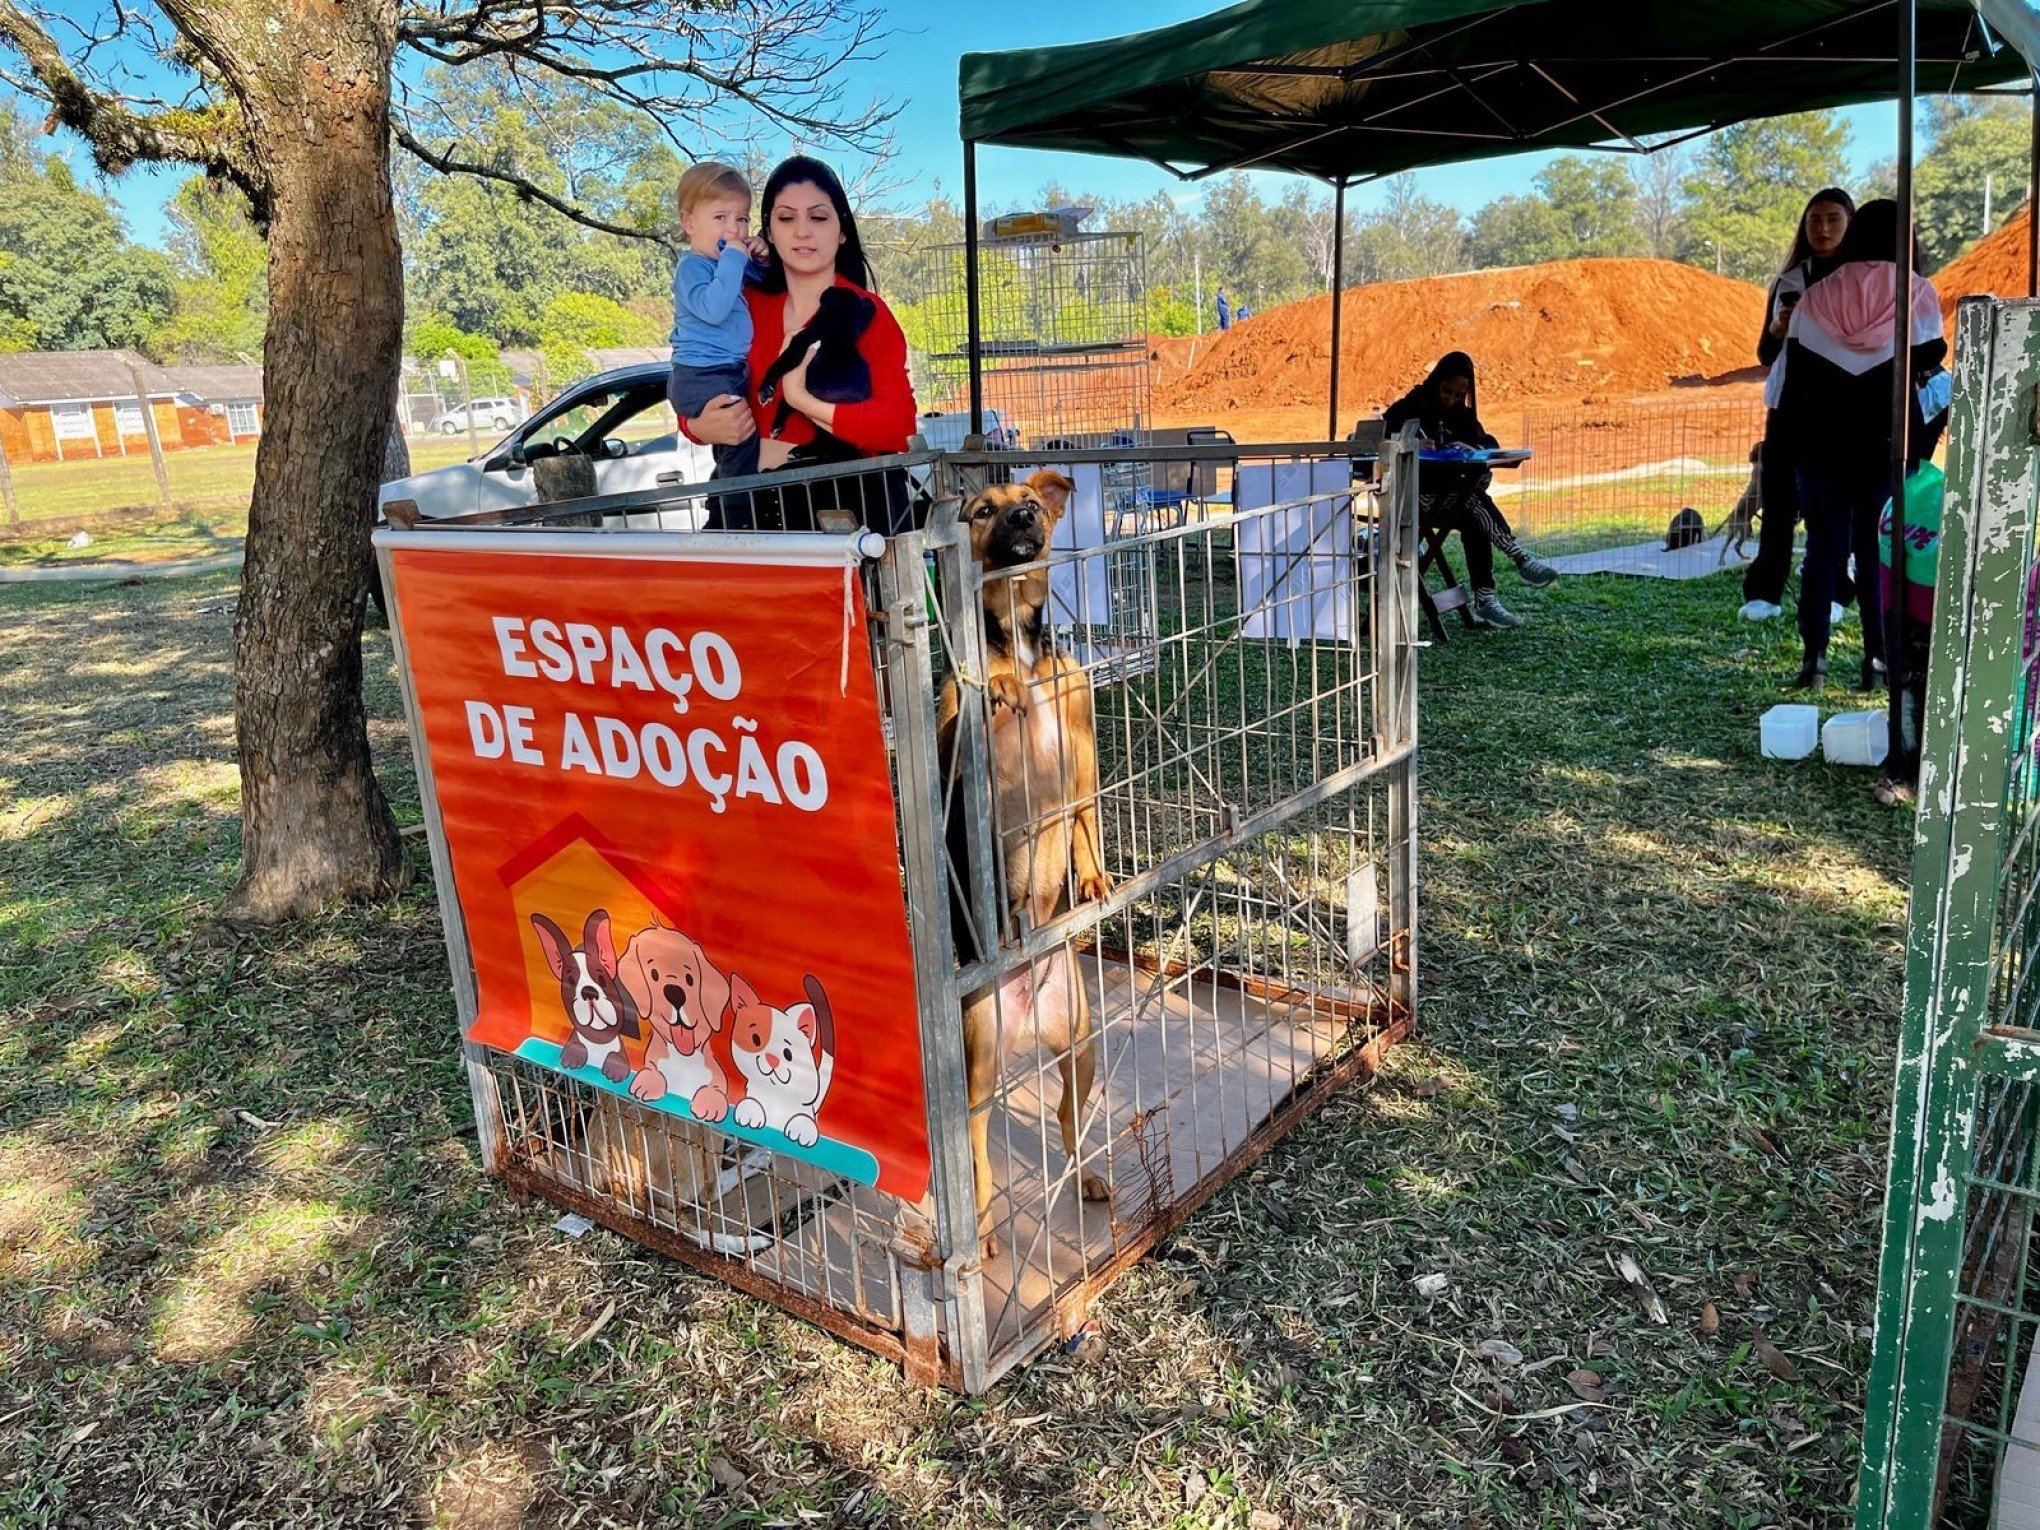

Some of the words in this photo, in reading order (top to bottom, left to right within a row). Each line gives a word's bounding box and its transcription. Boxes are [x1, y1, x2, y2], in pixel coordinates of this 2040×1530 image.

[492, 616, 741, 714] ESPAÇO
[465, 700, 545, 766] DE
[561, 712, 828, 813] ADOÇÃO
